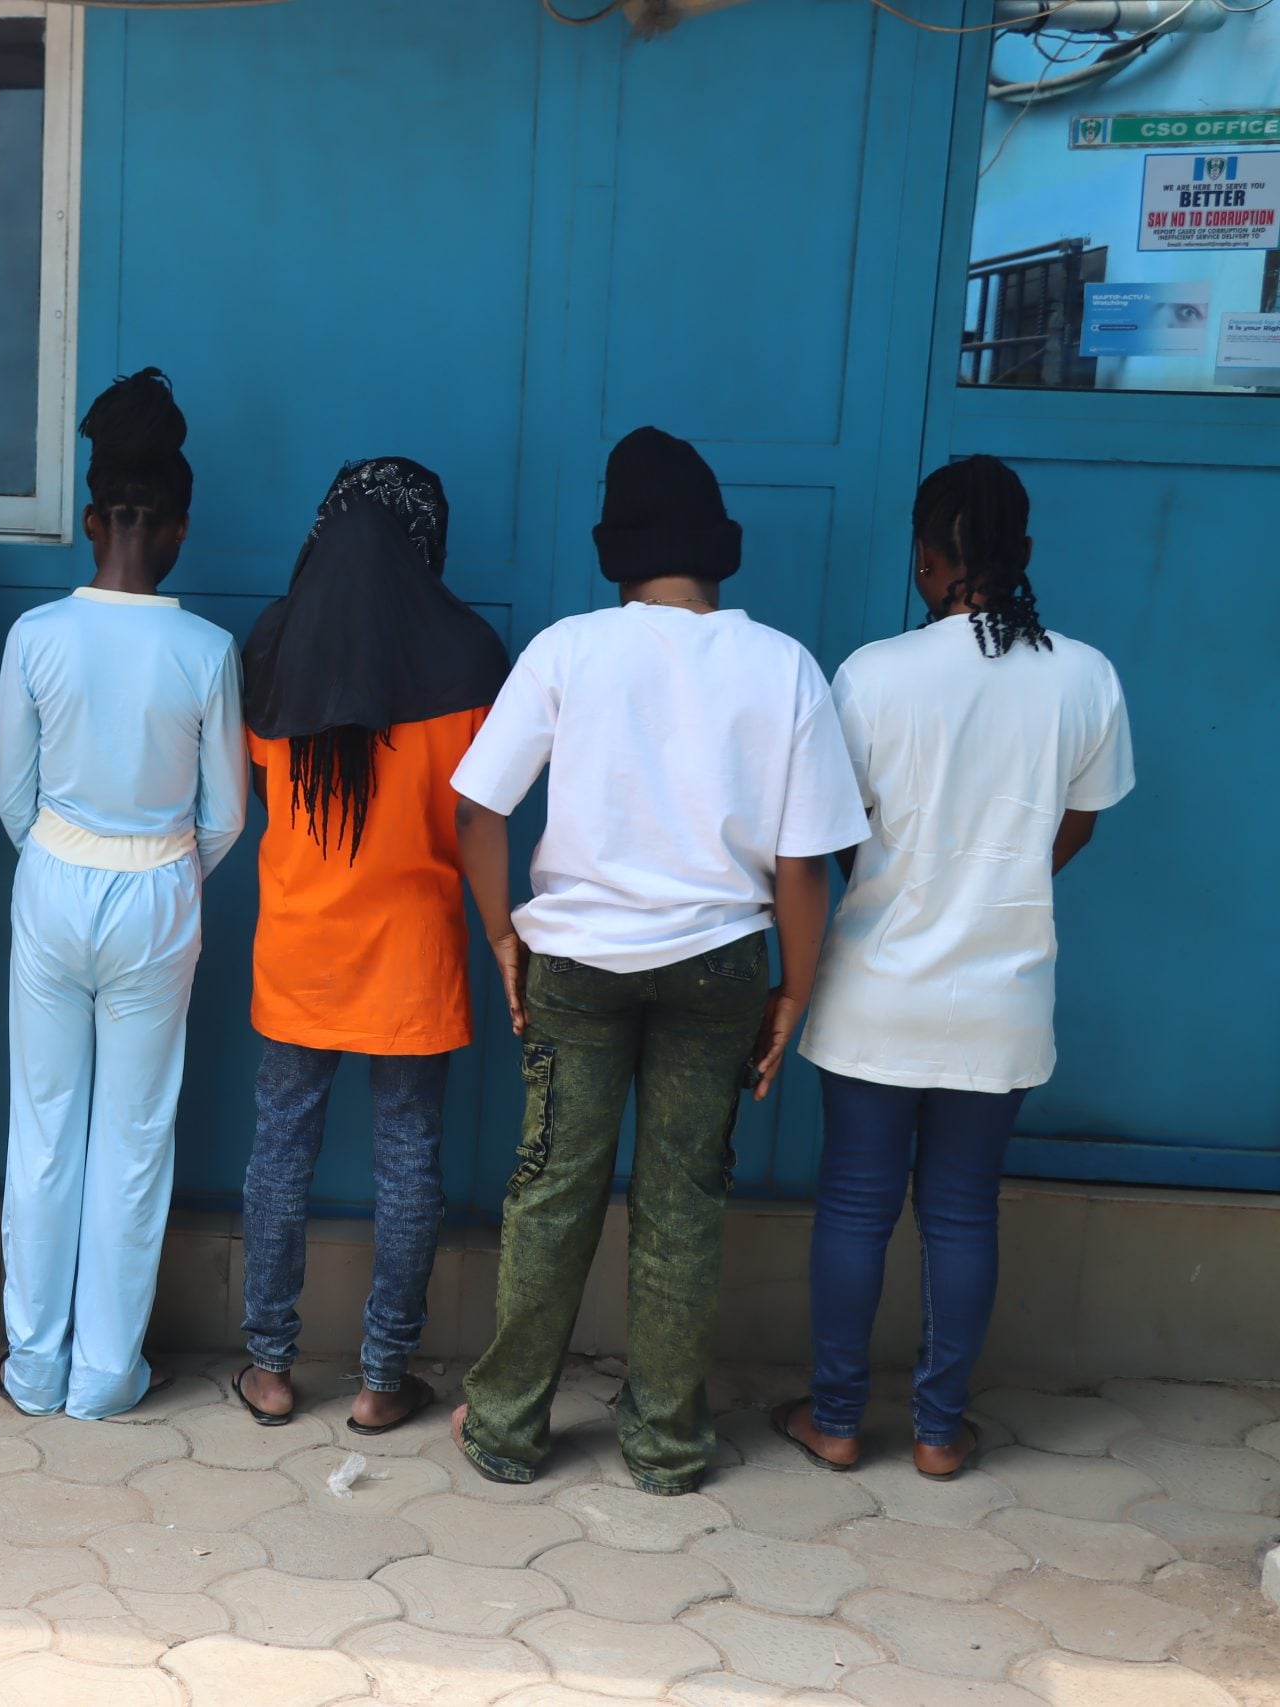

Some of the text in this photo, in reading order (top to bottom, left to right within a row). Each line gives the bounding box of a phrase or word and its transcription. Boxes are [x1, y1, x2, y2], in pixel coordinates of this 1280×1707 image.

[1141, 119, 1279, 137] CSO OFFICE
[1193, 183, 1211, 191] HERE
[1226, 182, 1248, 190] SERVE
[1179, 189, 1246, 208] BETTER
[1147, 209, 1275, 228] SAY NO TO CORRUPTION
[1153, 228, 1176, 236] REPORT
[1207, 227, 1249, 235] CORRUPTION
